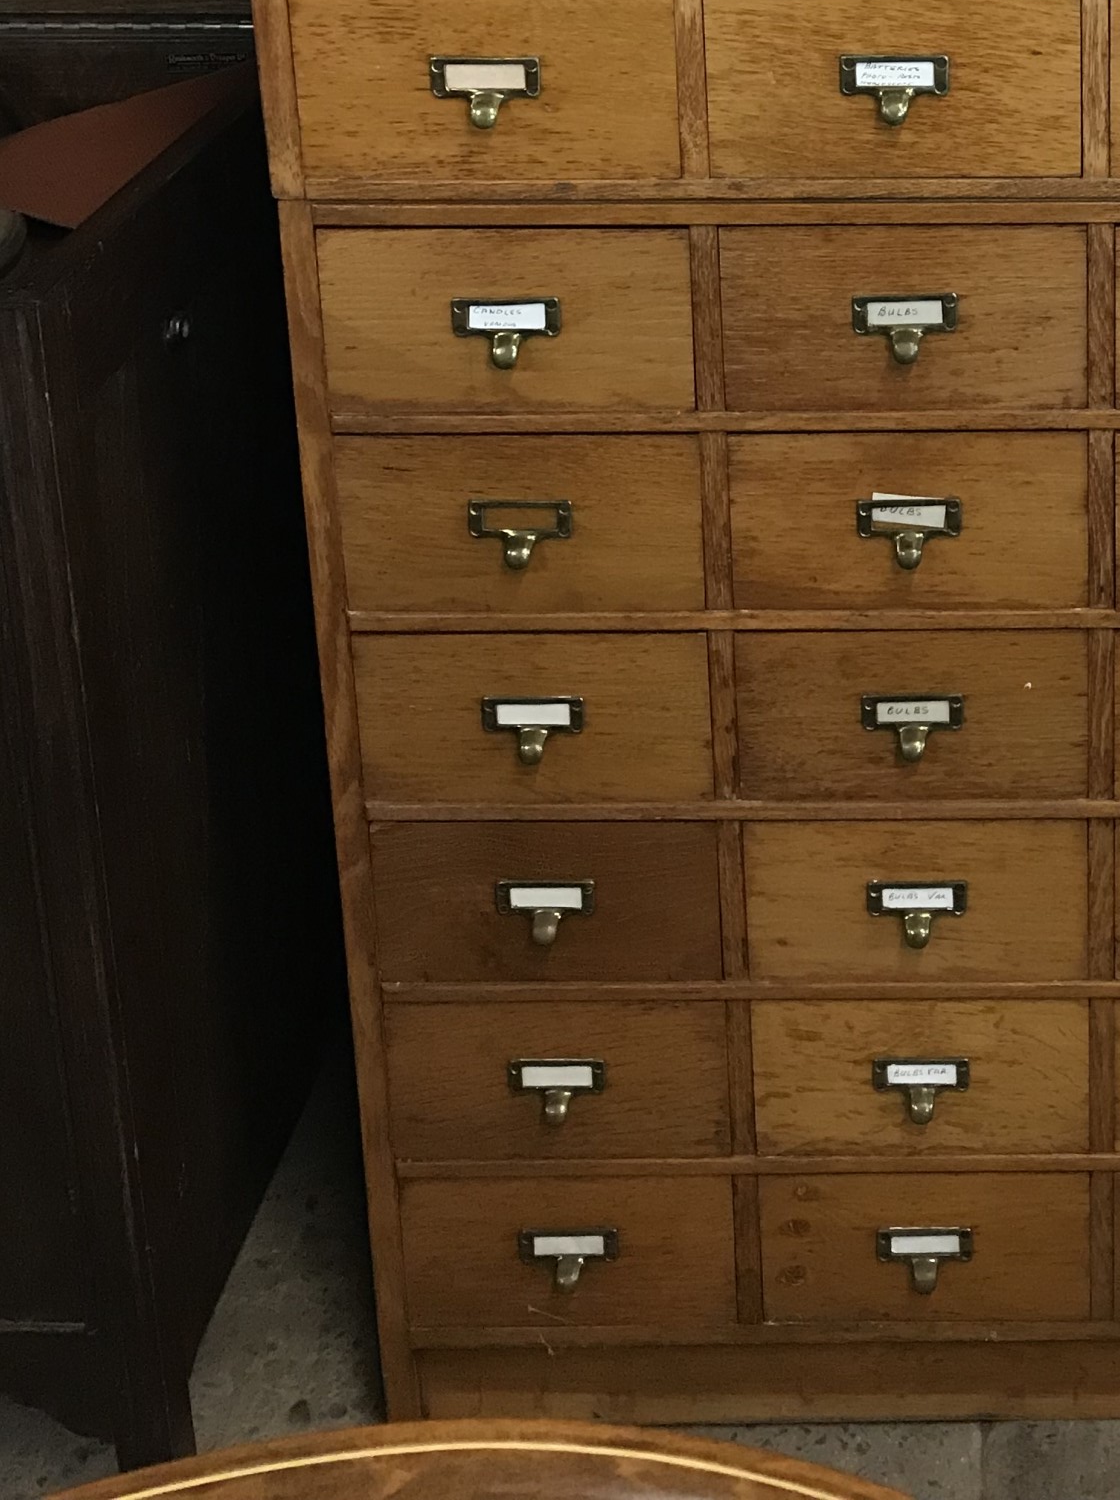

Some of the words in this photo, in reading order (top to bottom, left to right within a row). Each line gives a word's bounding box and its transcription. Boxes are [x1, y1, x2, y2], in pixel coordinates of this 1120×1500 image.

[473, 307, 522, 316] CANDLES
[878, 306, 919, 317] BULBS
[887, 706, 929, 716] BULBS
[888, 892, 918, 902] BULBS
[894, 1067, 923, 1078] BULBS
